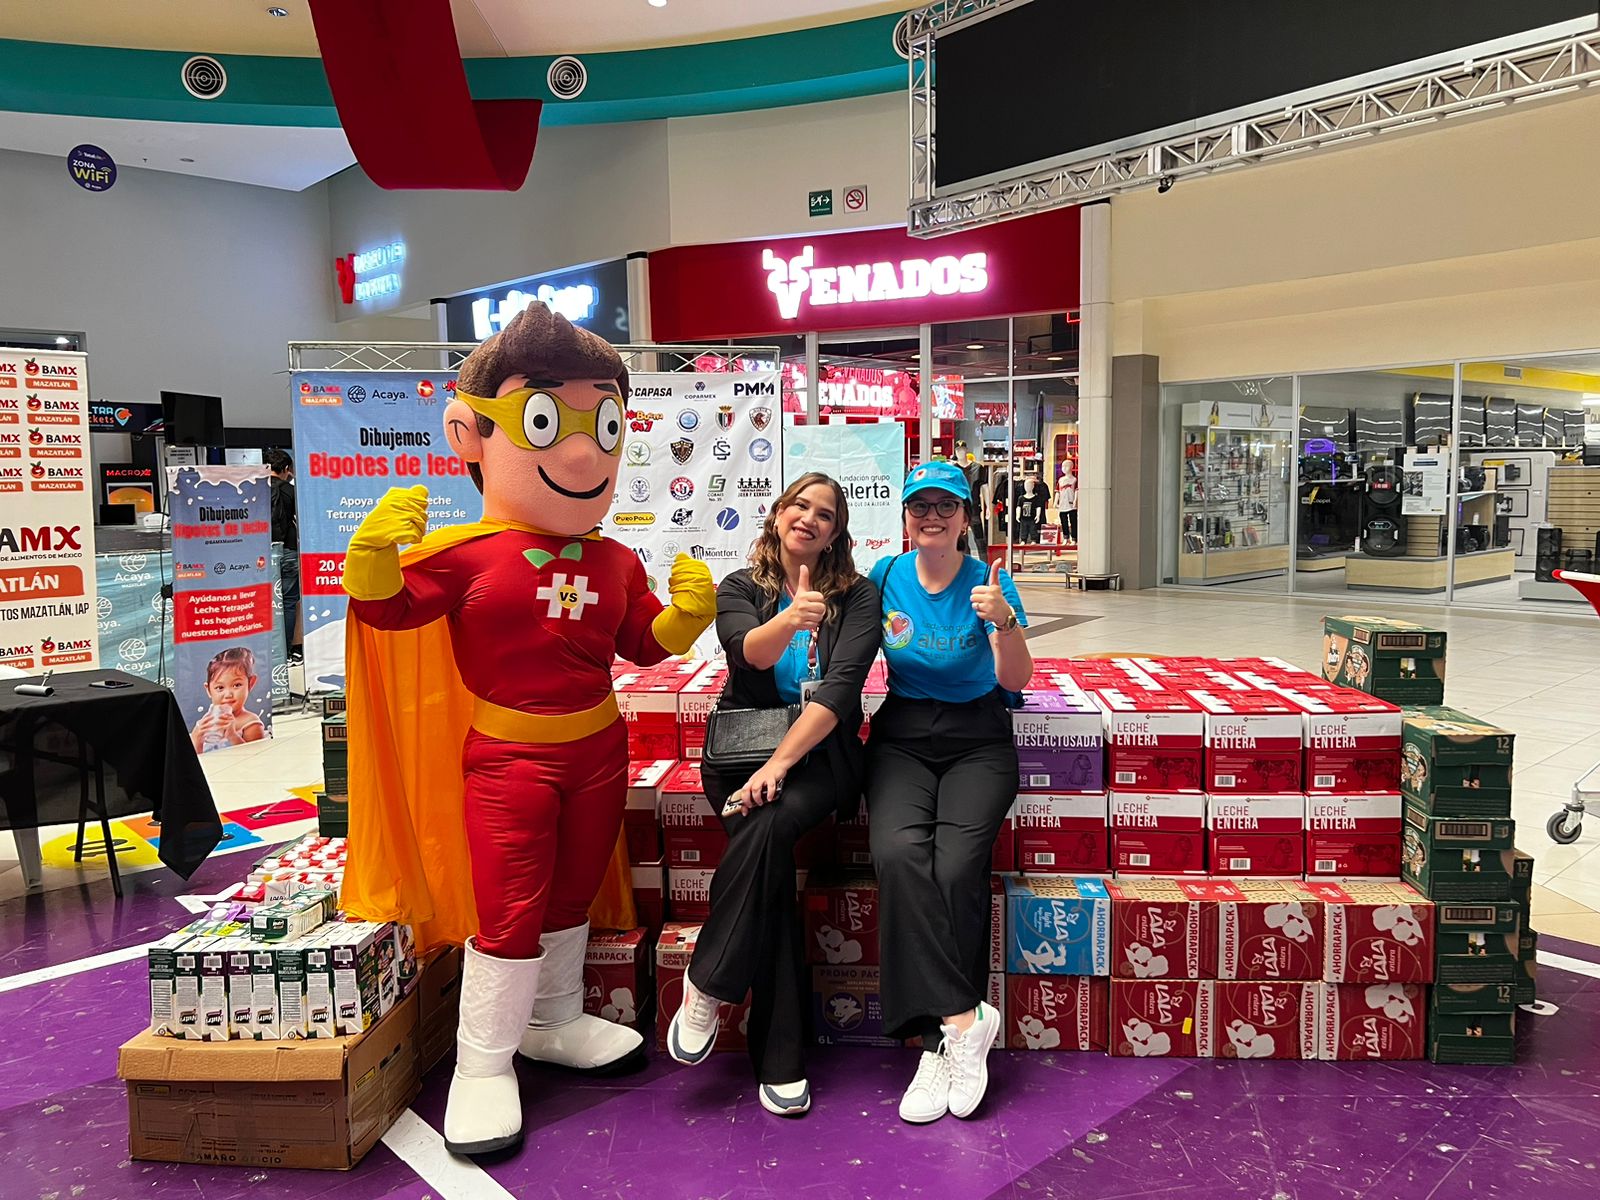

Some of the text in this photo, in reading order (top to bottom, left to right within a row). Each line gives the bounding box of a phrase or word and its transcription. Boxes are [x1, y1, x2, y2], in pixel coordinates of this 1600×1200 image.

[73, 159, 96, 169] ZONA
[73, 166, 109, 184] WiFi
[762, 245, 988, 320] VENADOS
[42, 365, 77, 376] BAMX
[33, 380, 70, 388] MAZATLÁN
[734, 382, 774, 396] PMM
[372, 390, 408, 401] Acaya.
[634, 388, 672, 397] CAPASA
[818, 382, 894, 408] ENADOS
[44, 400, 79, 410] BAMX
[46, 434, 81, 444] BAMX
[360, 427, 431, 450] Dibujemos
[309, 452, 469, 479] Bigotes de lec
[48, 468, 82, 476] BAMX
[870, 474, 890, 482] grupo
[842, 482, 890, 499] alerta
[340, 496, 374, 507] Apoya
[428, 496, 452, 505] eche
[200, 507, 249, 524] Dibujemos
[326, 509, 466, 522] Tetrapa ares de
[0, 526, 81, 552] AMX
[229, 564, 251, 572] Acaya.
[319, 560, 336, 571] 20
[0, 572, 59, 592] ATLÁN
[114, 572, 154, 582] Acaya.
[316, 575, 343, 585] mar
[189, 594, 231, 604] Ayúdanos
[240, 591, 256, 600] llevar
[21, 603, 90, 619] MAZATLÁN, IAP
[194, 602, 255, 614] Leche Tetrapack
[148, 614, 174, 624] Acay
[216, 614, 244, 626] hogares
[97, 620, 120, 631] aya.
[182, 623, 263, 638] nuestros beneficiarios.
[58, 640, 91, 650] BAMX
[918, 630, 977, 652] alerta
[116, 660, 156, 671] Acaya.
[684, 702, 710, 711] LECHE
[684, 712, 706, 723] ENTE
[1017, 723, 1050, 734] LECHE
[1117, 722, 1149, 732] LECHE
[1214, 725, 1246, 736] LECHE
[1314, 725, 1346, 735] LECHE
[1017, 735, 1097, 748] DESLACTOSADA
[1116, 734, 1158, 746] ENTERA
[1214, 737, 1256, 749] ENTERA
[1314, 737, 1356, 749] ENTERA
[1496, 737, 1510, 748] 12
[666, 804, 694, 813] LECHE
[1020, 804, 1051, 814] LECHE
[1117, 803, 1149, 814] LECHE
[1217, 806, 1249, 816] LECHE
[1314, 806, 1346, 816] LECHE
[666, 815, 703, 826] ENTERA
[1020, 816, 1061, 828] ENTERA
[1116, 815, 1158, 827] ENTERA
[1217, 818, 1258, 830] ENTERA
[1314, 818, 1356, 830] ENTERA
[1516, 862, 1529, 873] 12
[674, 879, 704, 888] LECHE
[675, 890, 710, 901] ENTER
[846, 892, 862, 931] LALA
[1050, 900, 1069, 940] LALA
[991, 902, 1000, 965] AHORRAPACK
[1148, 907, 1165, 948] LALA
[1097, 907, 1106, 968] AHORRAPACK
[1188, 908, 1198, 970] AHORRAPACK
[1225, 909, 1235, 972] AHORRAPACK
[1334, 912, 1342, 974] AHORRAPACK
[585, 952, 628, 961] RRAPACK
[1262, 937, 1280, 976] LALA
[1373, 940, 1389, 980] LALA
[861, 970, 880, 978] PAC
[1497, 986, 1510, 998] 12
[1039, 980, 1057, 1021] LALA
[1155, 984, 1172, 1024] LALA
[1259, 985, 1277, 1025] LALA
[181, 1014, 198, 1022] Nutri
[258, 1014, 275, 1022] Nutri
[312, 1012, 329, 1022] Nutri
[1080, 982, 1088, 1044] AHORRAPACK
[1304, 990, 1314, 1052] AHORRAPACK
[1326, 990, 1335, 1053] AHORRAPACK
[818, 1036, 824, 1044] 6
[827, 1036, 833, 1044] L
[1367, 1017, 1381, 1057] LALA
